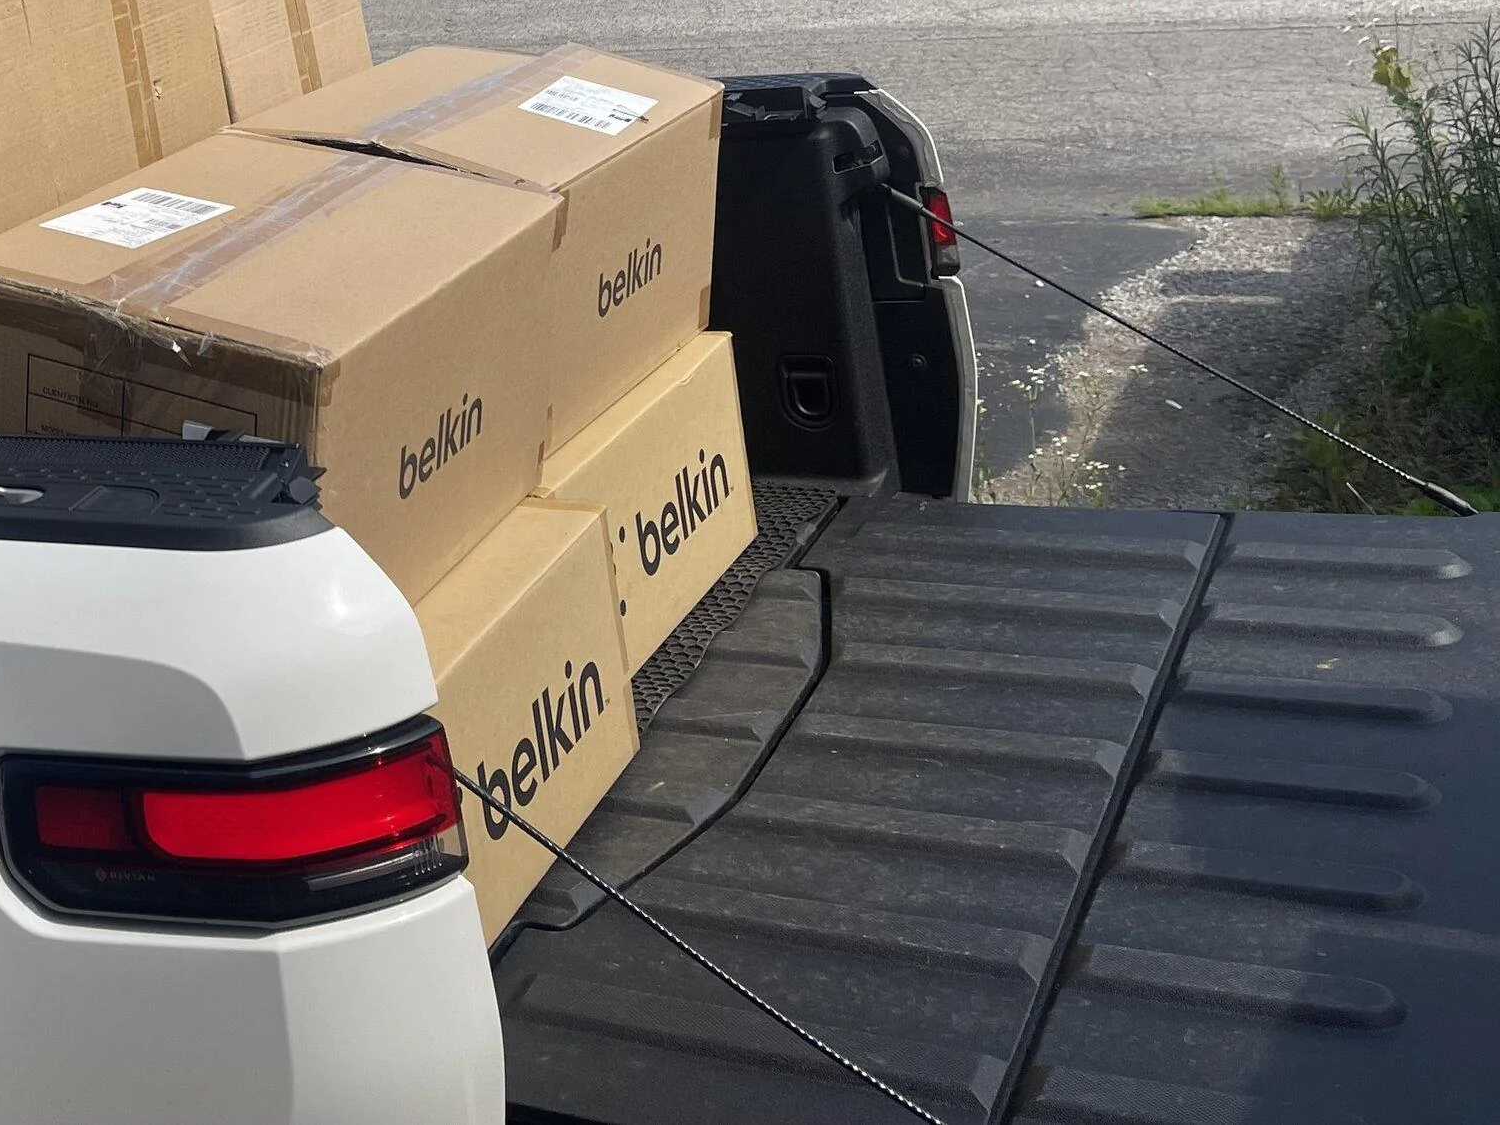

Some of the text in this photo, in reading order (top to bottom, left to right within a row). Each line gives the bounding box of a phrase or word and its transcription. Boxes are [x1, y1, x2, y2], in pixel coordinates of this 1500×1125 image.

[598, 237, 662, 318] belkin
[399, 392, 483, 501] belkin
[636, 448, 731, 576] belkin
[477, 660, 605, 841] belkin
